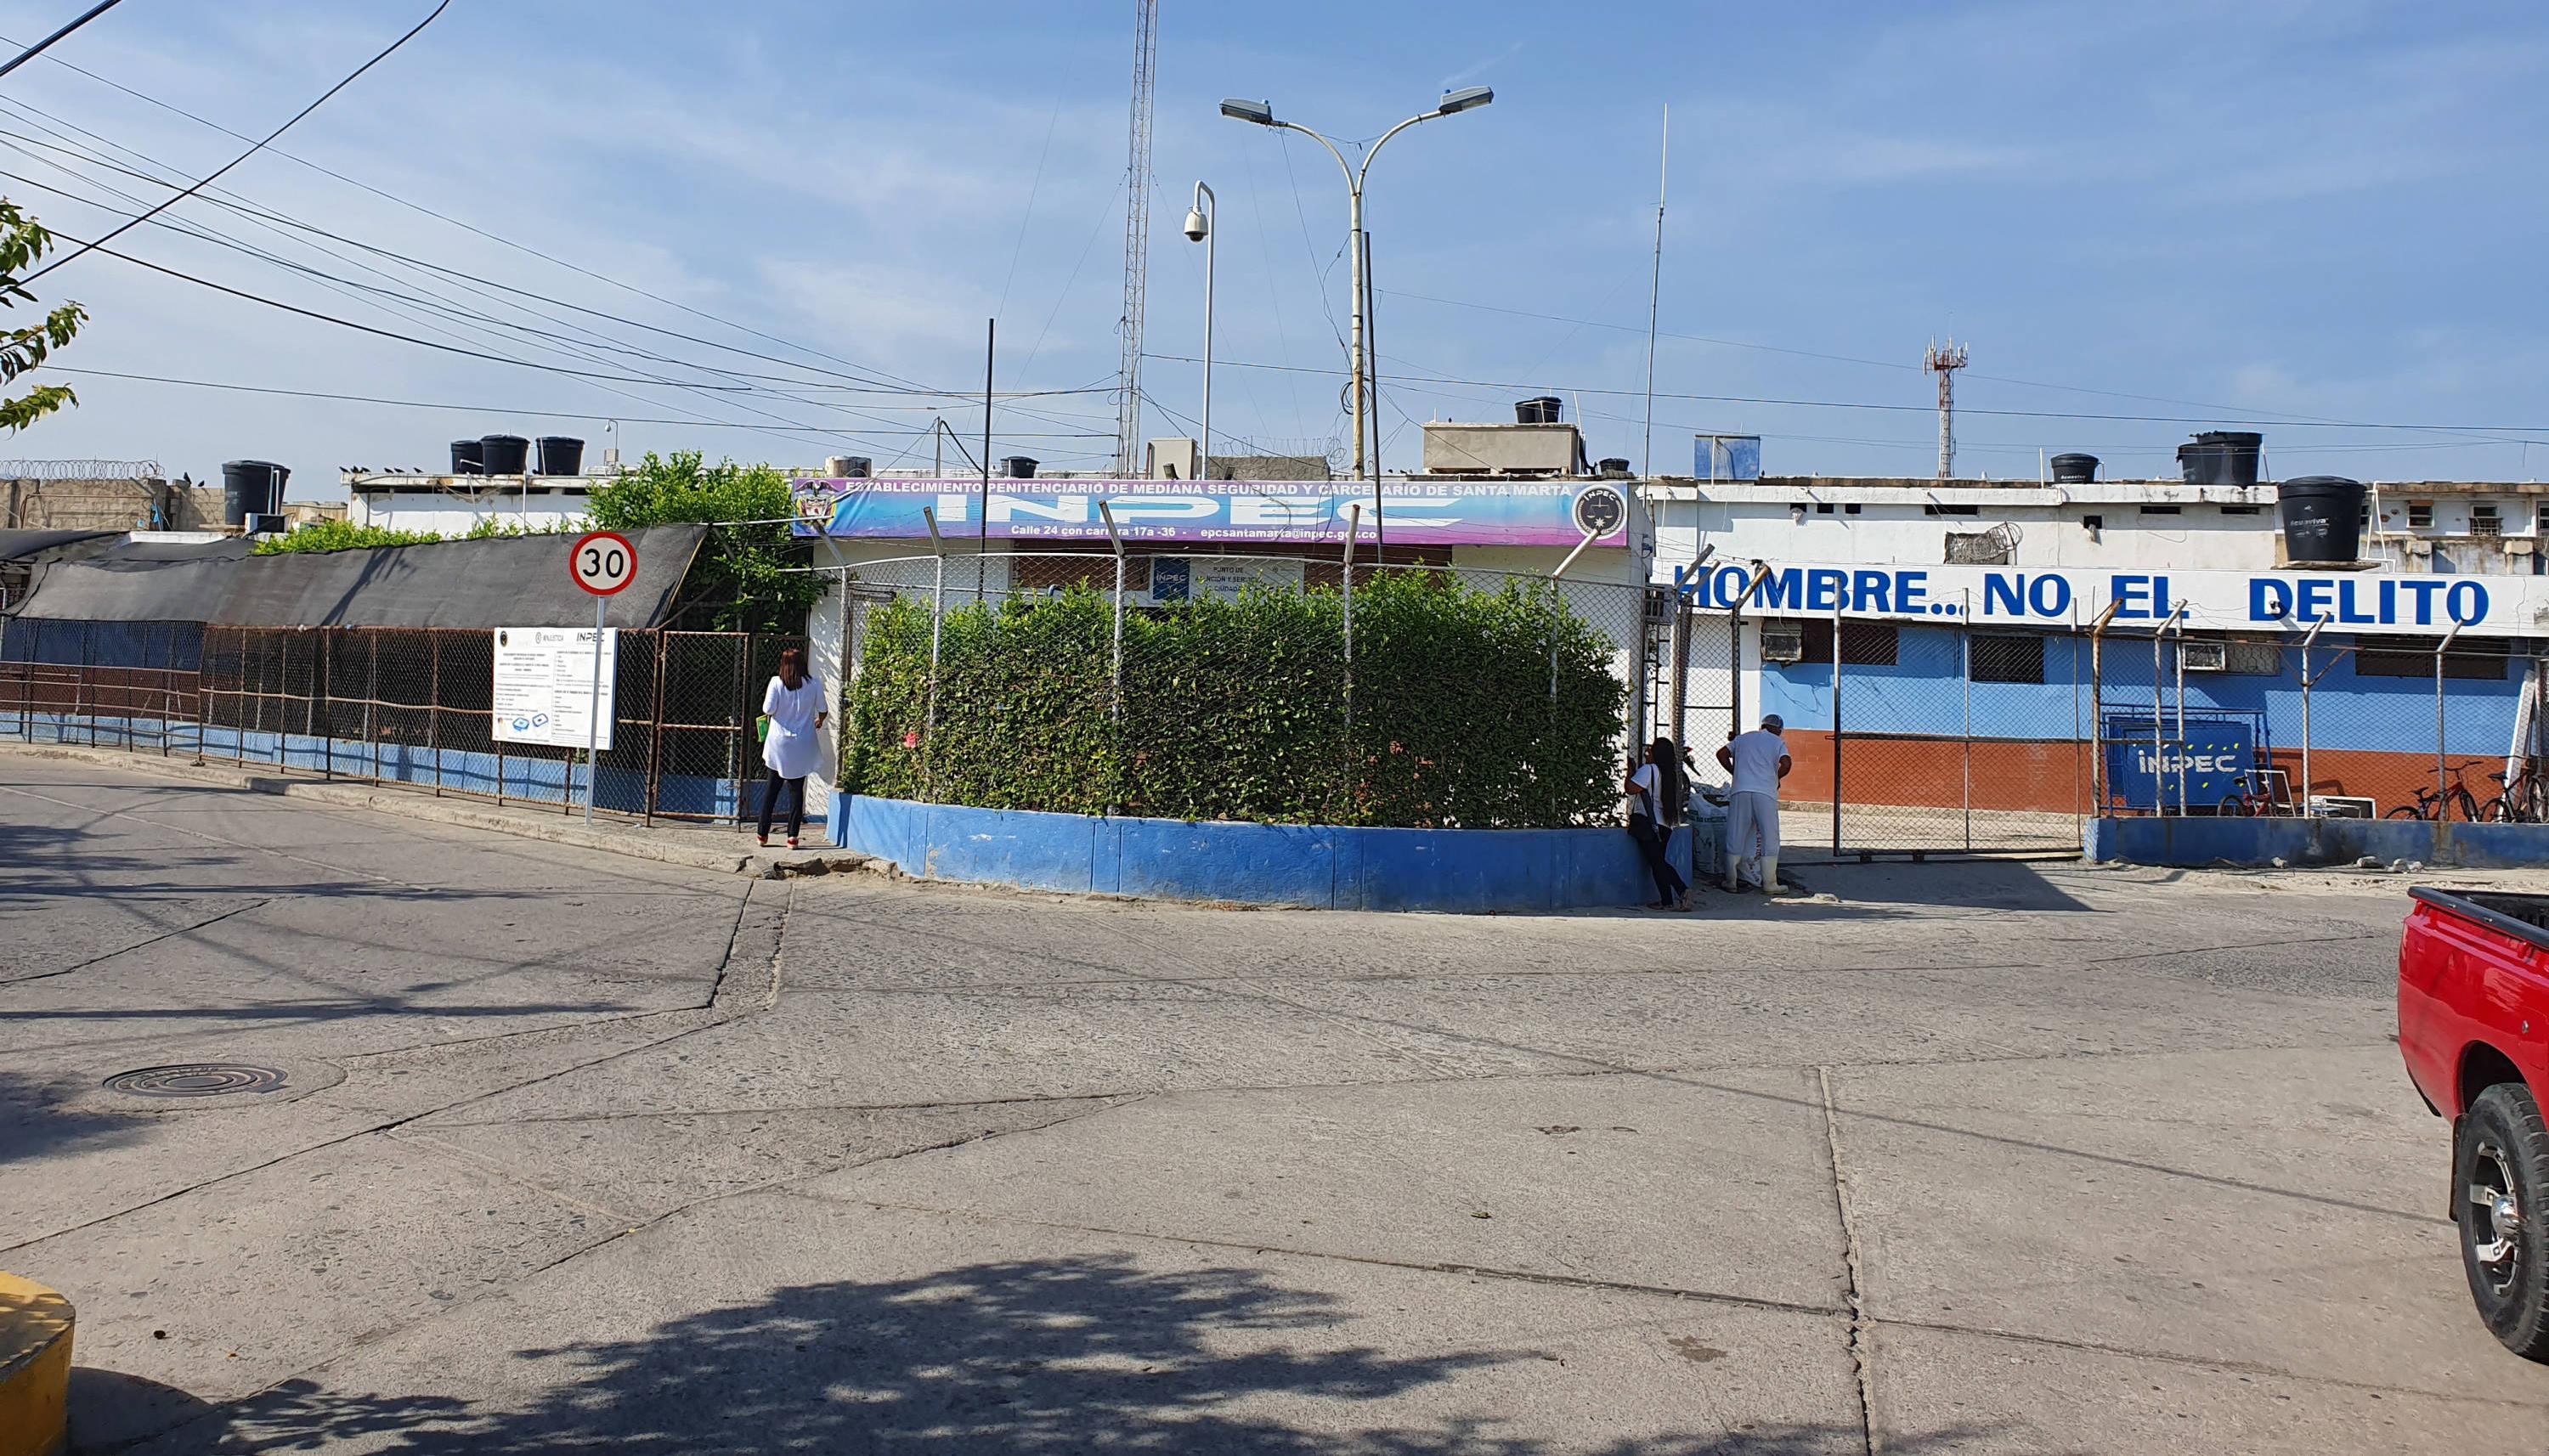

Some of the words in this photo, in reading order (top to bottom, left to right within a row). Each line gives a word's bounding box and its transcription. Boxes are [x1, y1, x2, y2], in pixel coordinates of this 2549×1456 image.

[845, 482, 982, 494] ESTABLECIMIENTO
[988, 483, 1104, 494] PENITENCIARIO
[1108, 484, 1128, 494] DE
[1133, 484, 1203, 494] MEDIANA
[1207, 484, 1297, 495] SEGURIDAD
[1304, 485, 1314, 495] Y
[1427, 485, 1448, 496] DE
[1453, 485, 1509, 497] SANTA
[1513, 486, 1572, 496] MARTA
[1583, 489, 1616, 501] INPEC
[936, 494, 1464, 526] INPEC
[1011, 525, 1041, 534] Calle
[1043, 526, 1058, 534] 24
[1086, 528, 1129, 536] carrra
[1133, 527, 1154, 536] 17a
[582, 548, 625, 578] 30
[1985, 573, 2071, 618] NO
[2111, 575, 2190, 619] EL
[2249, 578, 2490, 627] DELITO
[2138, 749, 2237, 773] INPEC
